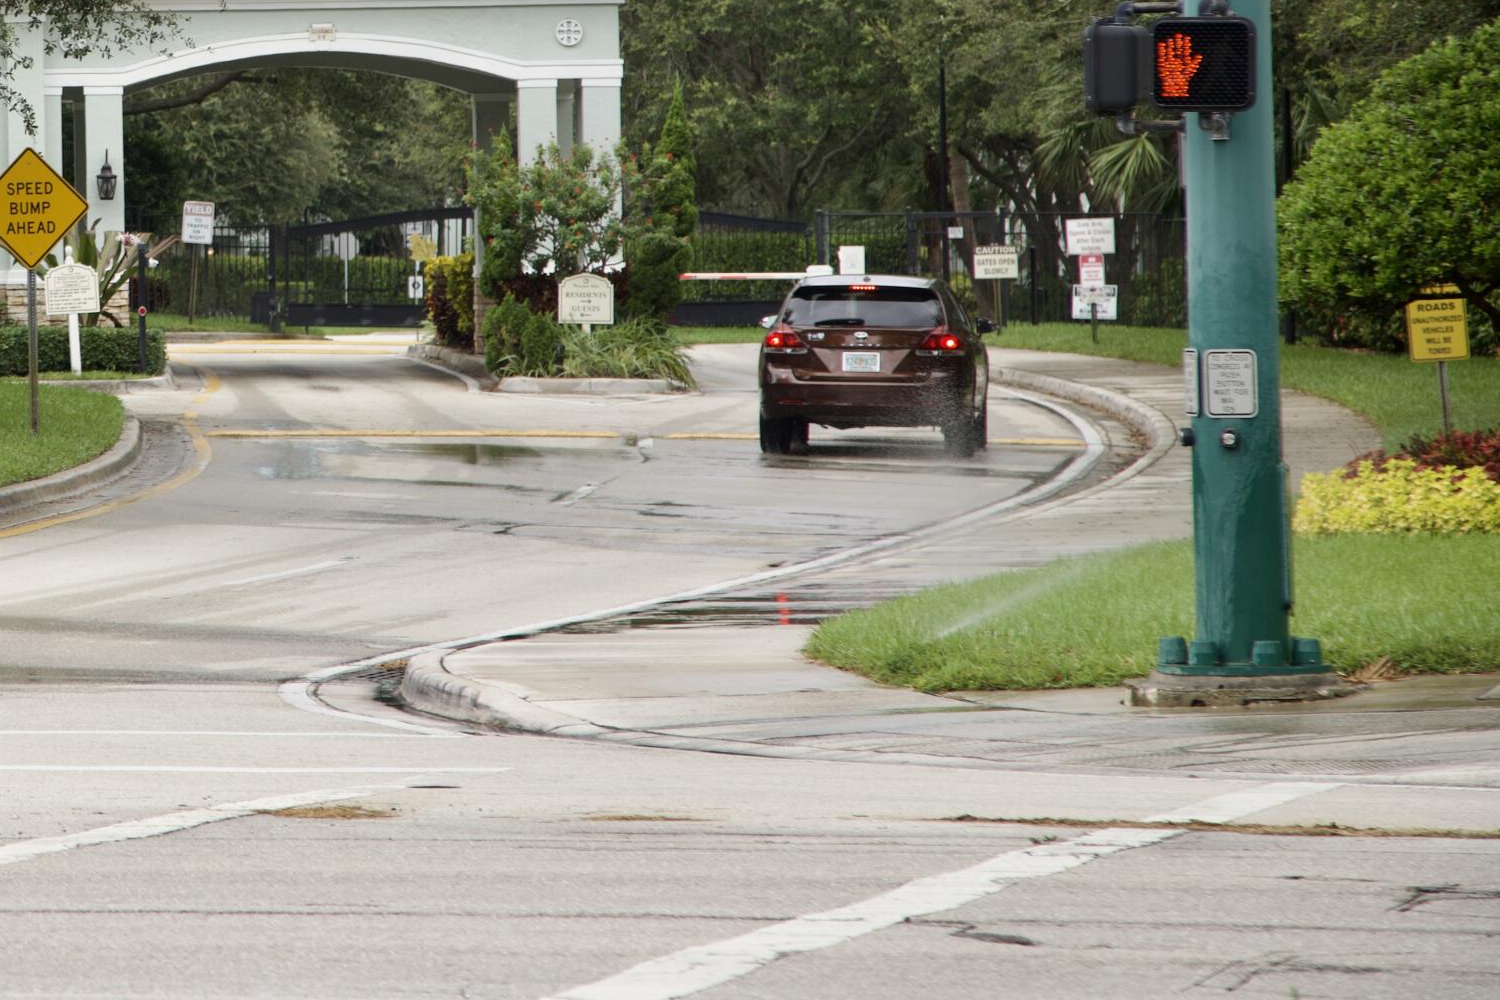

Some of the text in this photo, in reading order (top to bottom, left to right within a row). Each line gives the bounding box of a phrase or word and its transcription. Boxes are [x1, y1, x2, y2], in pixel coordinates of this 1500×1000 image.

[6, 181, 54, 196] SPEED
[9, 201, 51, 215] BUMP
[186, 203, 213, 215] YIELD
[6, 221, 56, 235] AHEAD
[975, 246, 1016, 255] CAUTION
[976, 258, 1016, 266] GATES OPEN
[984, 267, 1008, 275] SLOWLY
[565, 291, 607, 299] RESIDENTS
[571, 305, 601, 313] GUESTS
[1417, 302, 1456, 312] ROADS
[1412, 315, 1462, 324] UNAUTHORIZED
[1422, 326, 1455, 335] VEHICLES
[1426, 336, 1453, 345] WILL BE
[1428, 347, 1452, 355] TOWED
